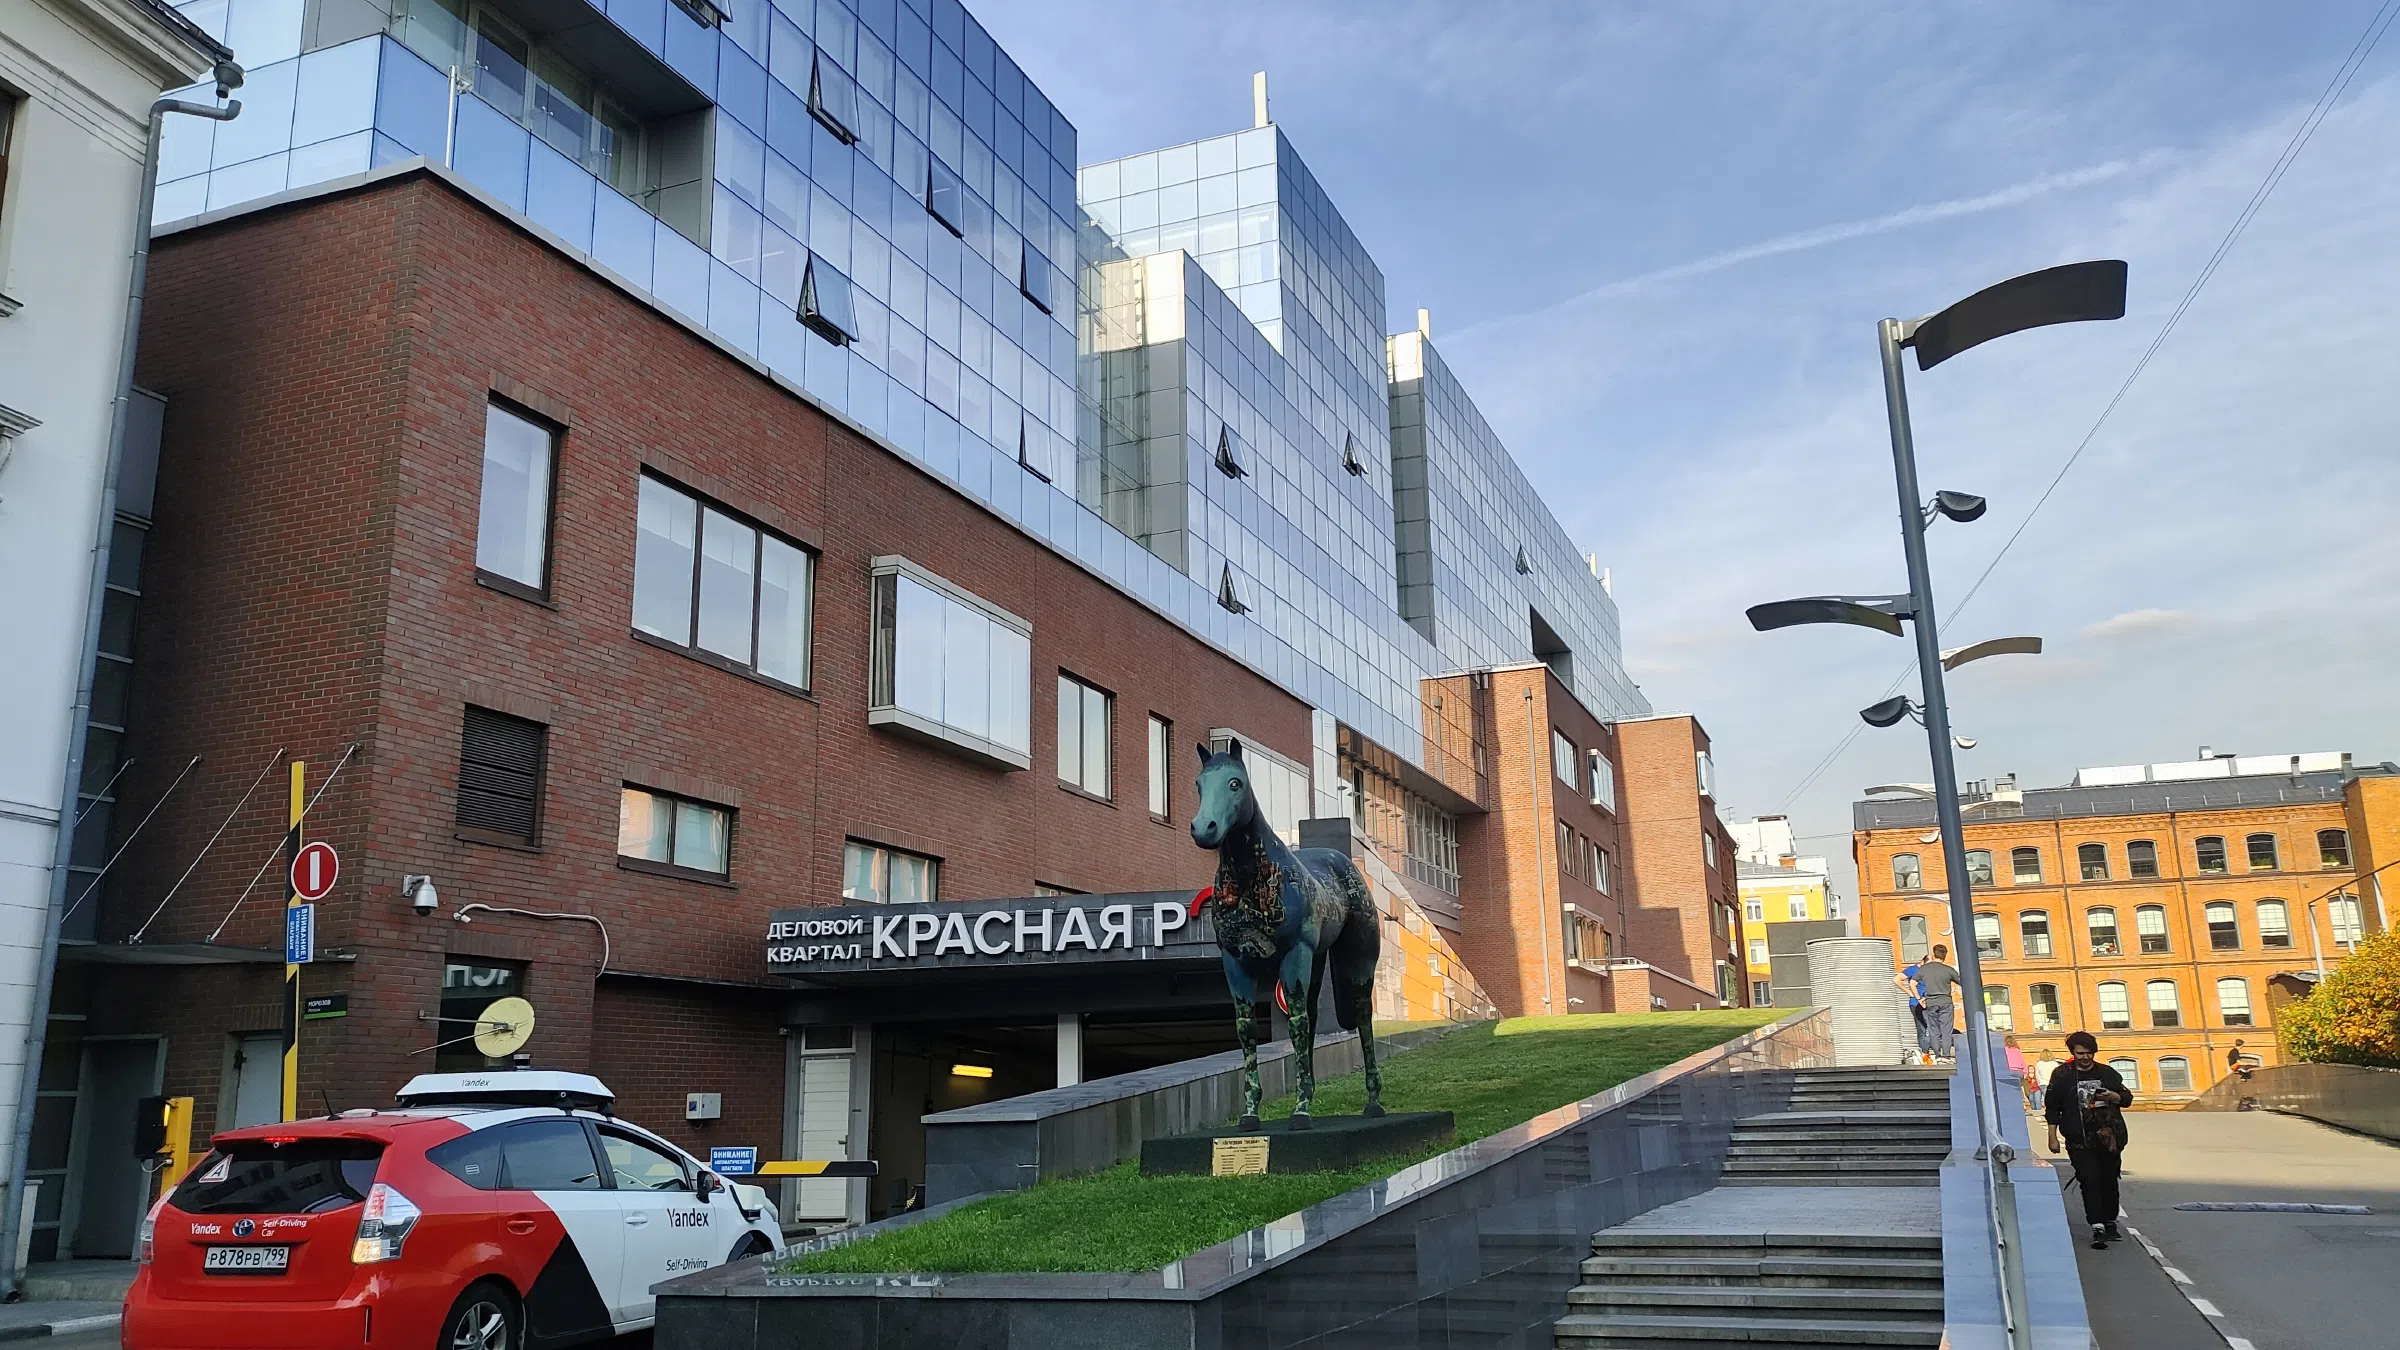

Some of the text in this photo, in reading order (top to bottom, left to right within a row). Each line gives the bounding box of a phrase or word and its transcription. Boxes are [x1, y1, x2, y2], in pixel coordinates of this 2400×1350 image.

[300, 908, 308, 960] ВНИМАНИЕ!
[766, 914, 863, 941] ДЕЛОВОЙ
[872, 904, 1135, 959] КРАСНАЯ
[766, 943, 862, 963] КВАРТАЛ
[461, 1079, 491, 1087] Yandex
[713, 1150, 753, 1159] ВНИМАНИЕ!
[262, 1219, 308, 1228] Self-Driving
[666, 1208, 709, 1227] Yandex
[191, 1222, 222, 1235] Yandex
[261, 1228, 275, 1237] Car
[666, 1258, 708, 1271] Self-Driving
